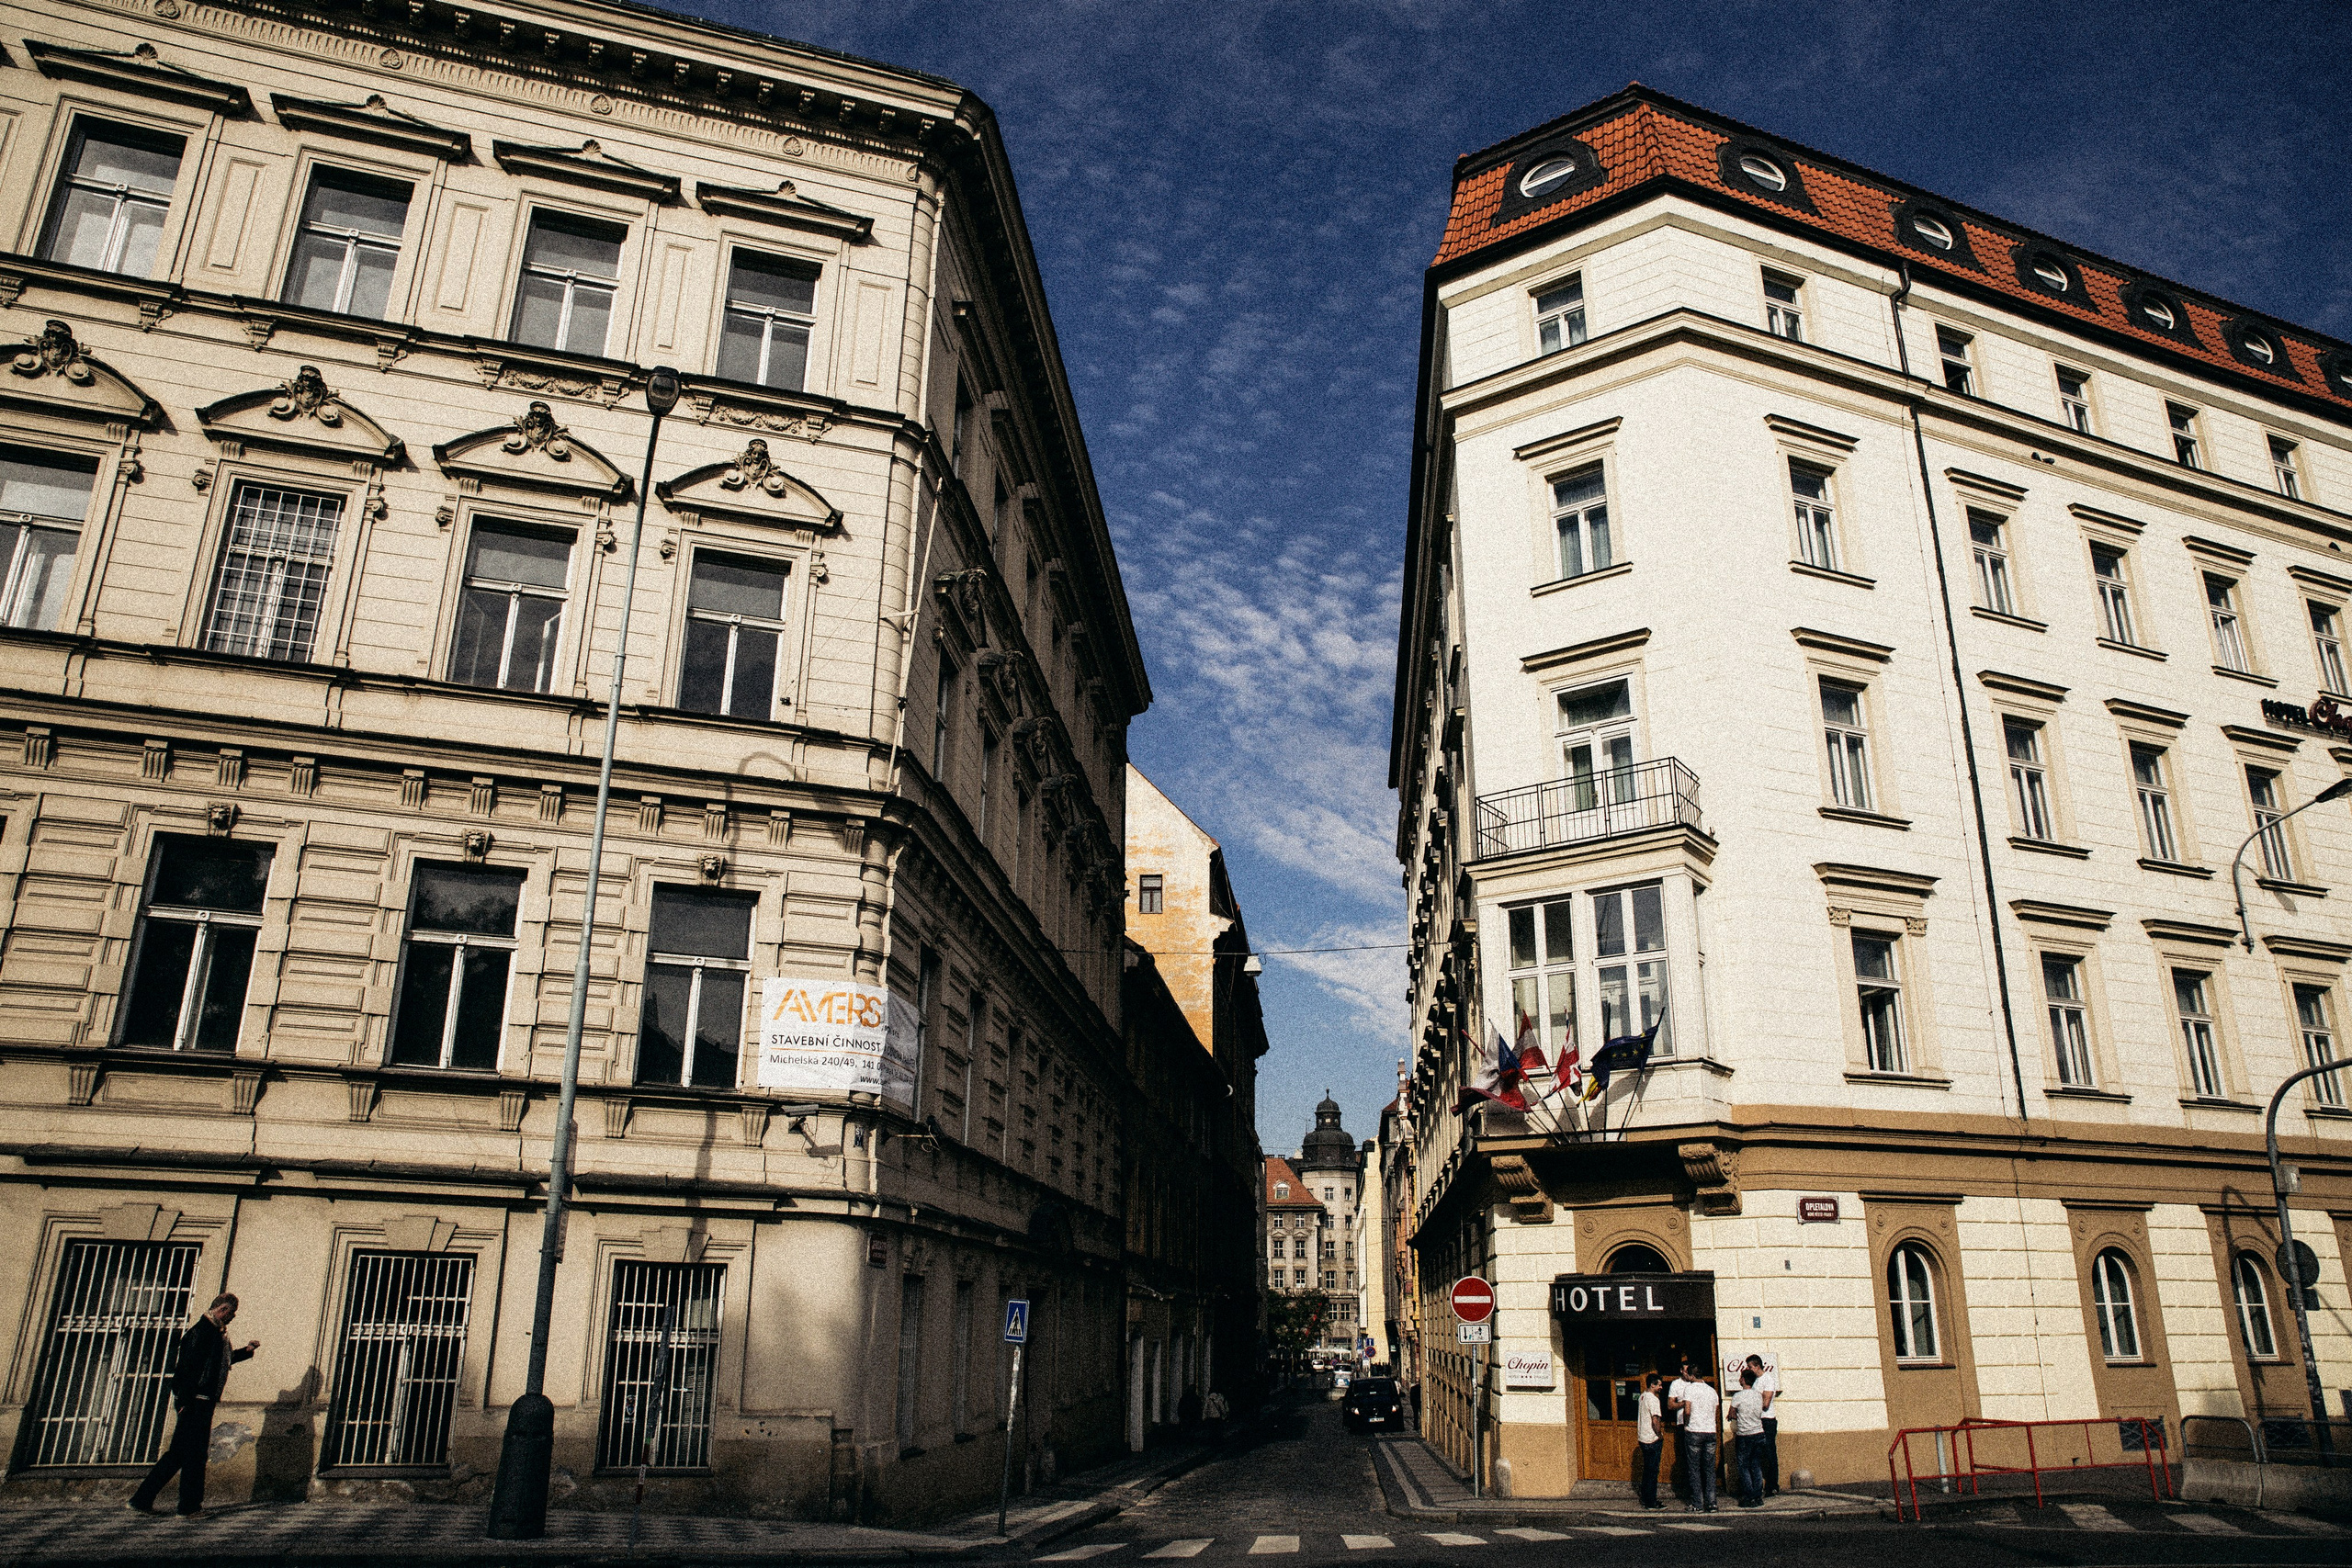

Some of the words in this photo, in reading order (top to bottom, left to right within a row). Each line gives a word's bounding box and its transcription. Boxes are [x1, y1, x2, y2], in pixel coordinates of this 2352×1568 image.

[773, 988, 882, 1028] AVERS
[771, 1034, 829, 1046] STAVEBNÍ
[832, 1035, 881, 1052] ČINNOST
[770, 1055, 819, 1065] Michelská
[821, 1056, 858, 1068] 240/49,
[862, 1059, 875, 1070] 141
[1555, 1286, 1664, 1312] HOTEL
[1508, 1356, 1548, 1373] Chopin
[1727, 1359, 1774, 1372] Chin
